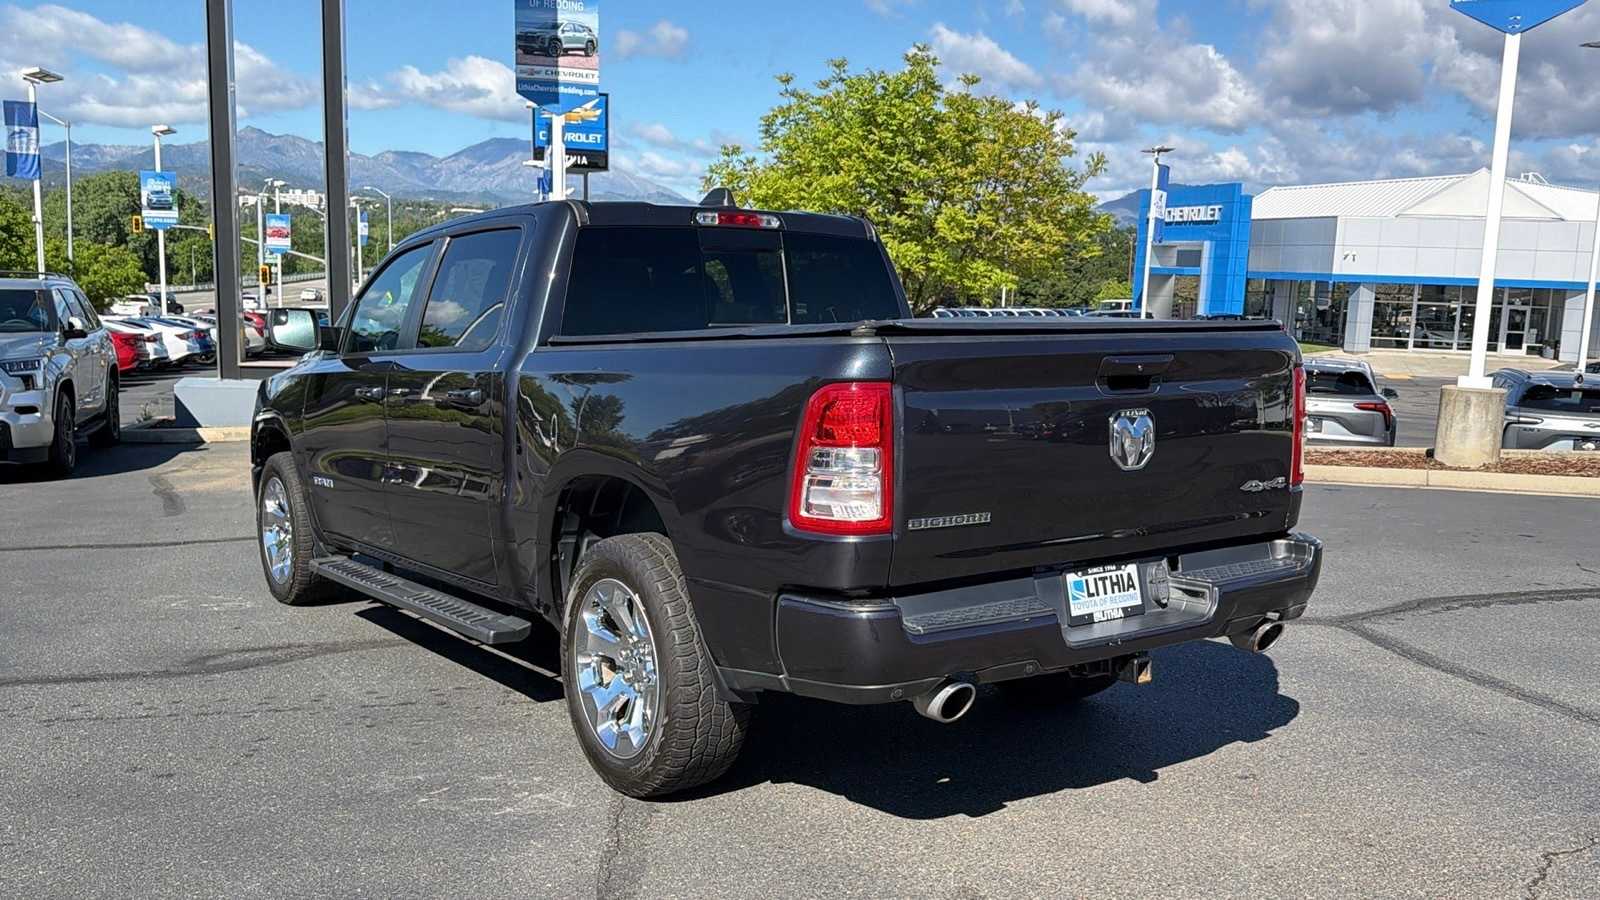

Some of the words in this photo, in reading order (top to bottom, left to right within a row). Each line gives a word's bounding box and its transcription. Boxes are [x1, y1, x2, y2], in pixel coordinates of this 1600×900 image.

[544, 69, 596, 79] CHEVROLET
[1165, 205, 1223, 222] CHEVROLET
[1085, 572, 1137, 598] LITHIA
[1072, 600, 1099, 611] TOYOTA
